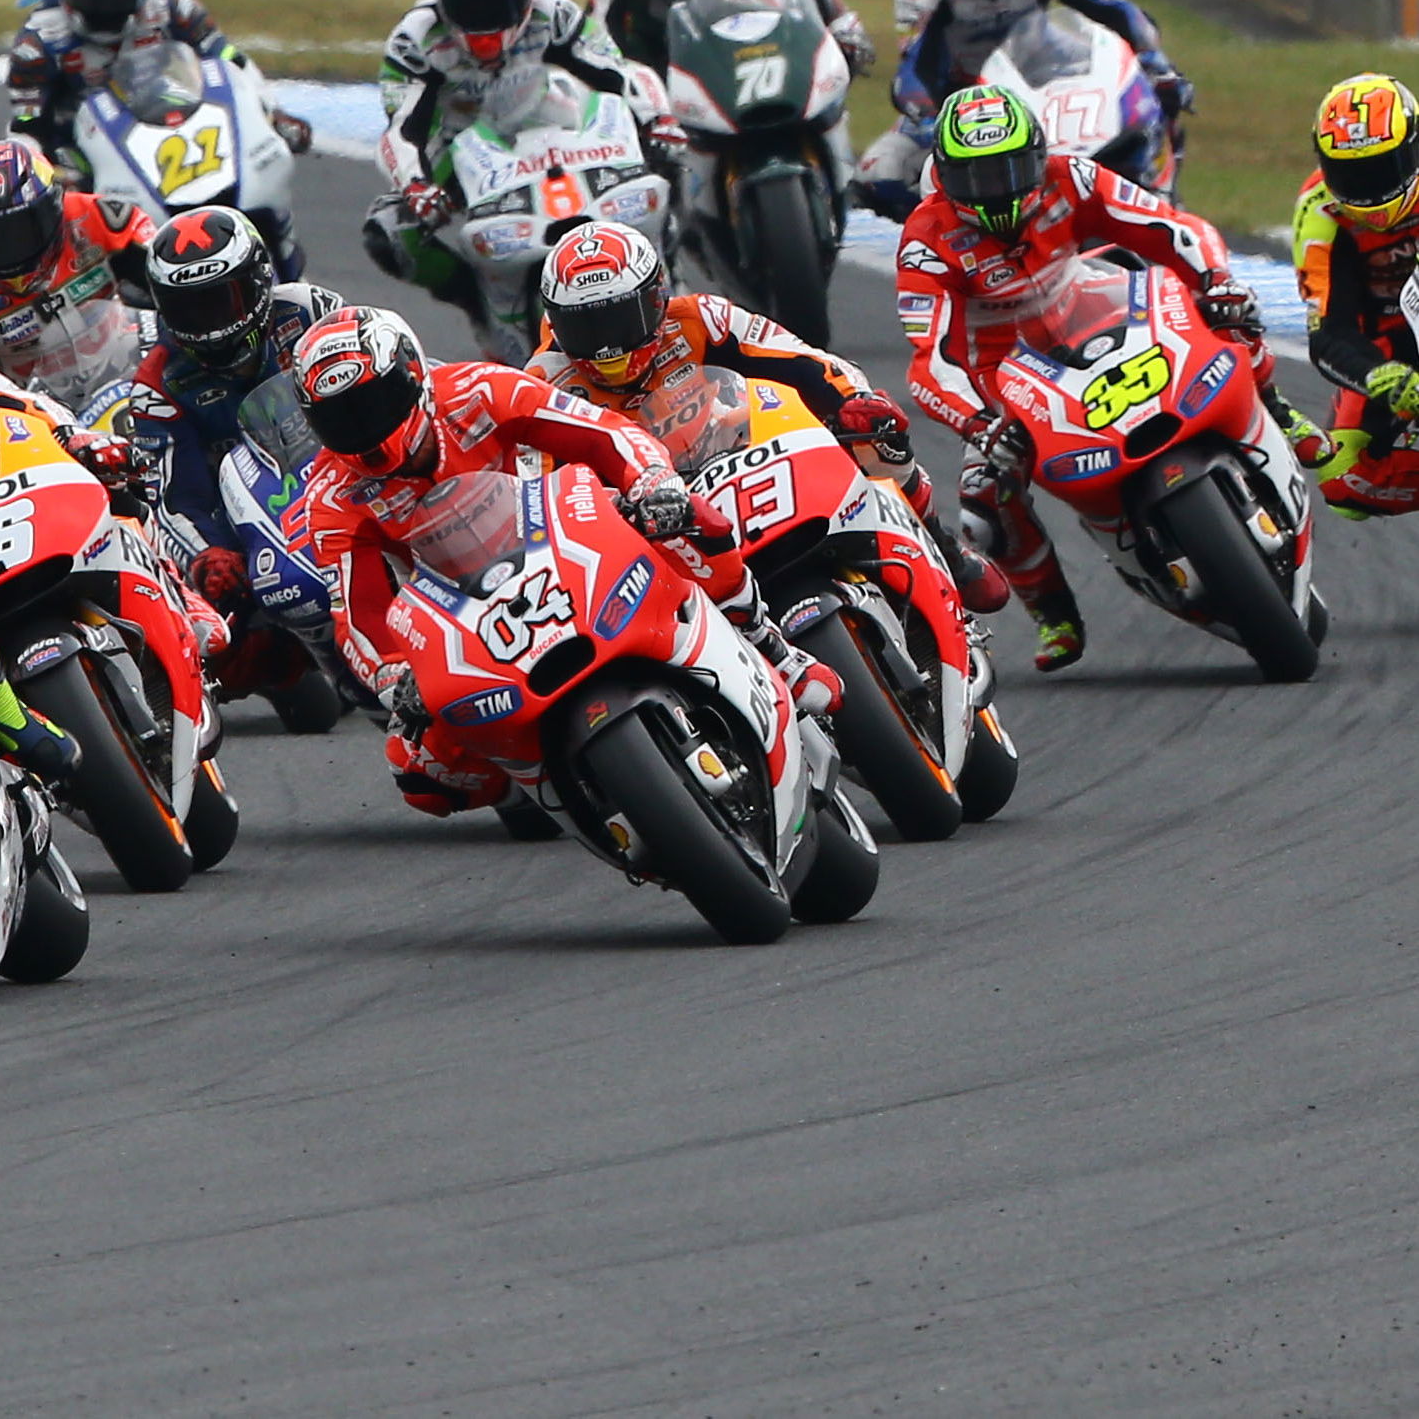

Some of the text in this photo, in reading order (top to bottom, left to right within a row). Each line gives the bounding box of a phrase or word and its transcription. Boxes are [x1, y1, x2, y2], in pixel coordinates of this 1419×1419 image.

[735, 56, 787, 107] 70
[1320, 87, 1395, 148] 41
[974, 130, 1003, 142] Arai
[156, 126, 224, 196] 21
[540, 170, 584, 220] 8
[176, 261, 220, 282] HJC
[576, 271, 610, 287] SHOEI
[1159, 295, 1192, 331] riello
[319, 340, 357, 356] DUCATI
[655, 340, 687, 367] REPSOL
[316, 368, 357, 391] SUOMY
[1015, 353, 1058, 380] ADVANCE
[1201, 354, 1234, 388] TIM
[909, 380, 966, 428] DUCATI
[1000, 377, 1051, 423] riello ups
[1082, 344, 1171, 430] 35
[689, 439, 789, 499] EPSOL
[1075, 449, 1112, 474] TIM
[565, 488, 598, 523] riello
[260, 585, 302, 607] ENEOS
[414, 576, 459, 610] ADVANCE
[618, 562, 651, 606] TIM
[385, 598, 427, 651] riello ups
[478, 568, 576, 664] 04
[528, 629, 564, 660] DUCATI
[342, 638, 377, 696] DUCA
[474, 689, 514, 719] TIM
